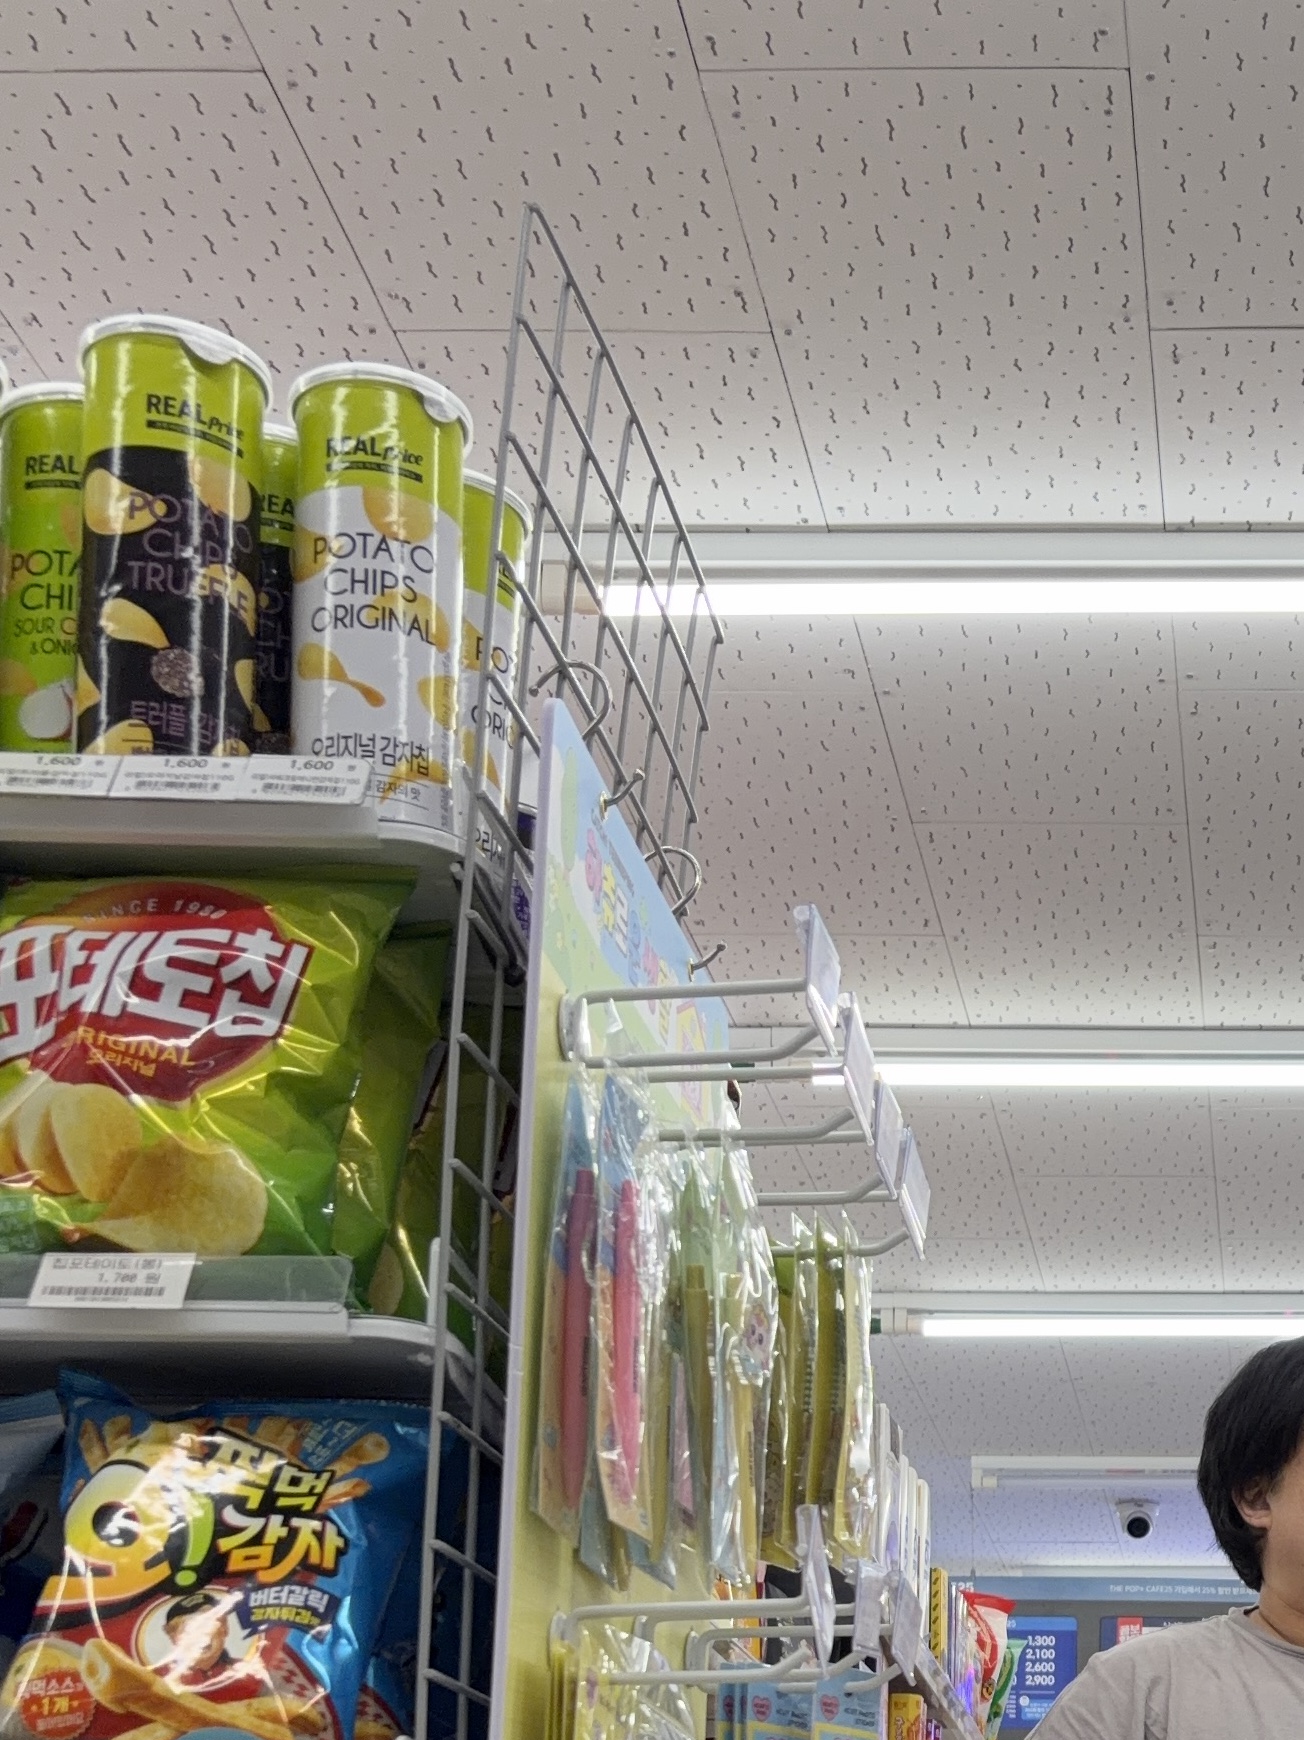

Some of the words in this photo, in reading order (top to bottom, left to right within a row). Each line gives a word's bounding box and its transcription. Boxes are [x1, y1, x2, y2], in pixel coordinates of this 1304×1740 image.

[146, 394, 208, 425] REAL
[26, 455, 79, 475] REAL
[313, 532, 435, 574] POTATO
[324, 567, 418, 604] CHIPS
[14, 618, 55, 638] SOUR
[311, 603, 437, 646] ORIGINAL
[290, 759, 334, 771] 1,600
[311, 733, 376, 759] 오리지널
[380, 736, 430, 776] 감자칩
[216, 1504, 345, 1584] 감자
[249, 1585, 330, 1612] 버터갈릭
[1027, 1635, 1056, 1646] 1,300
[1025, 1648, 1056, 1660] 2,100
[1025, 1661, 1055, 1673] 2,600
[1025, 1674, 1055, 1686] 2,900
